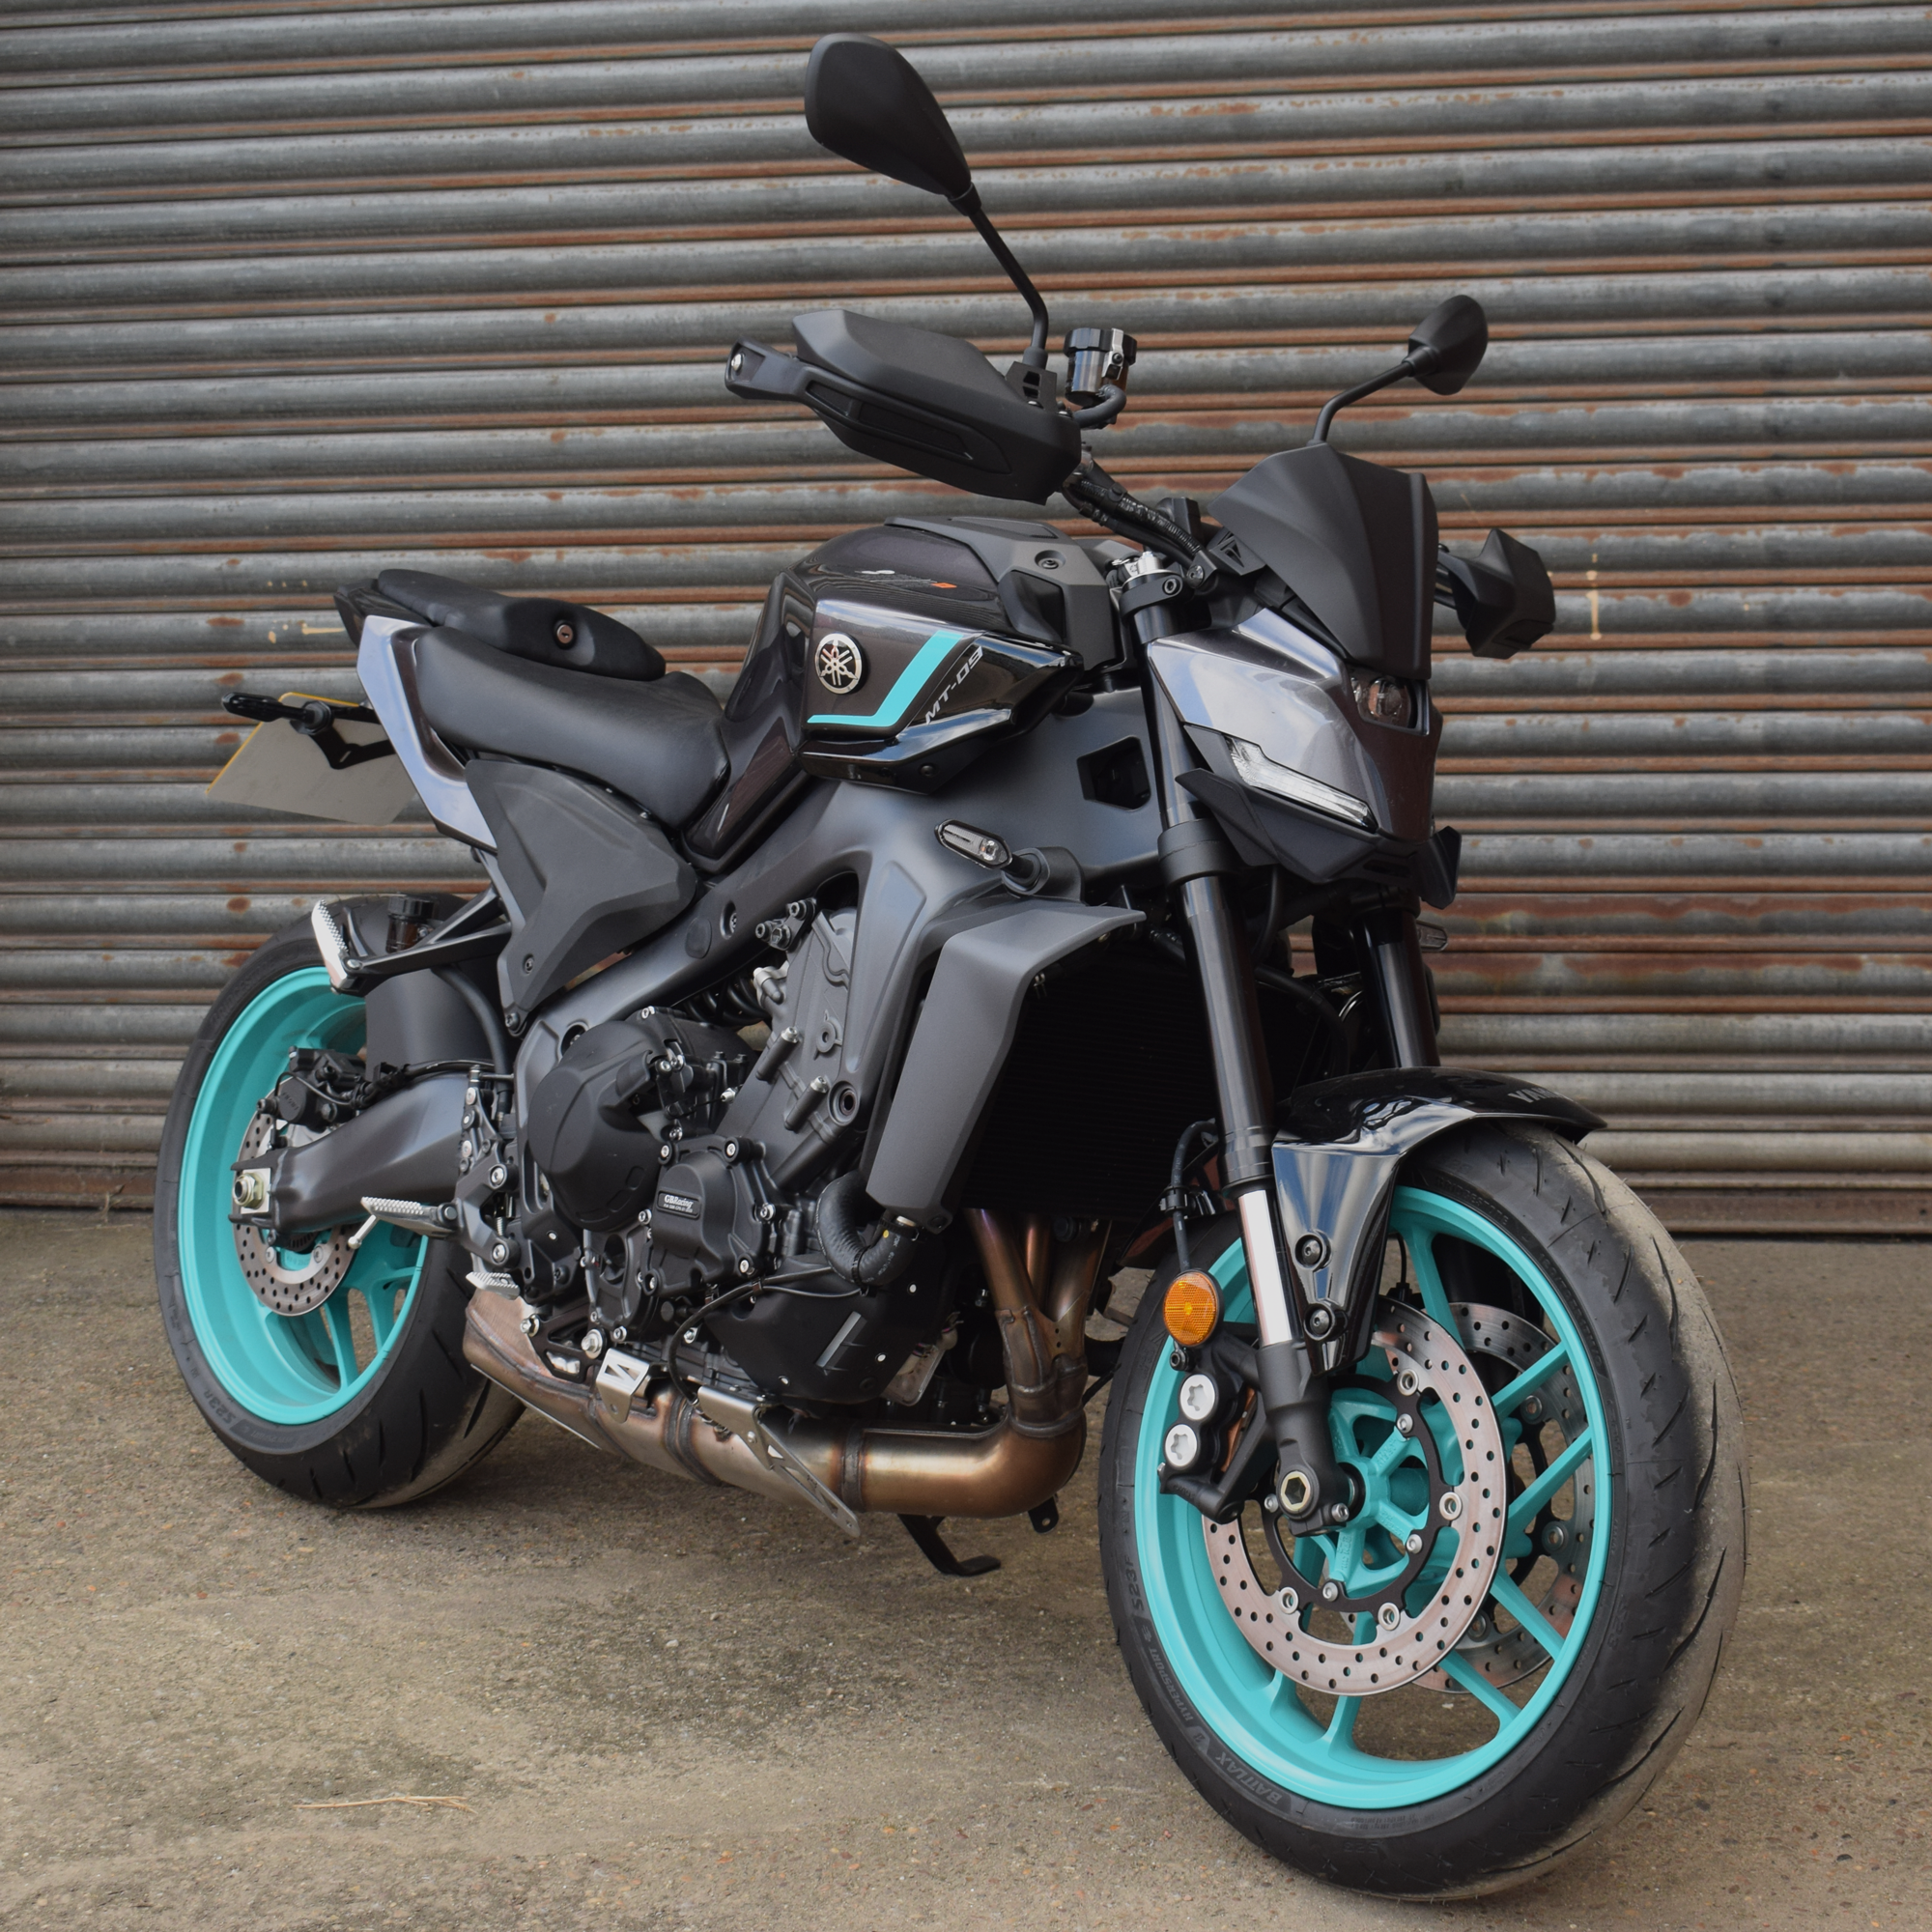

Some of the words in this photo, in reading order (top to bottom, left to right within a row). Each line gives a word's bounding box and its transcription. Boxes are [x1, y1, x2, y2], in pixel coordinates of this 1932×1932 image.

[923, 645, 984, 725] MT-09
[664, 1194, 694, 1208] GBRacing
[1123, 1554, 1146, 1611] S23F
[1149, 1647, 1194, 1722] HYPERSPORT
[1217, 1753, 1282, 1804] BATTLAX
